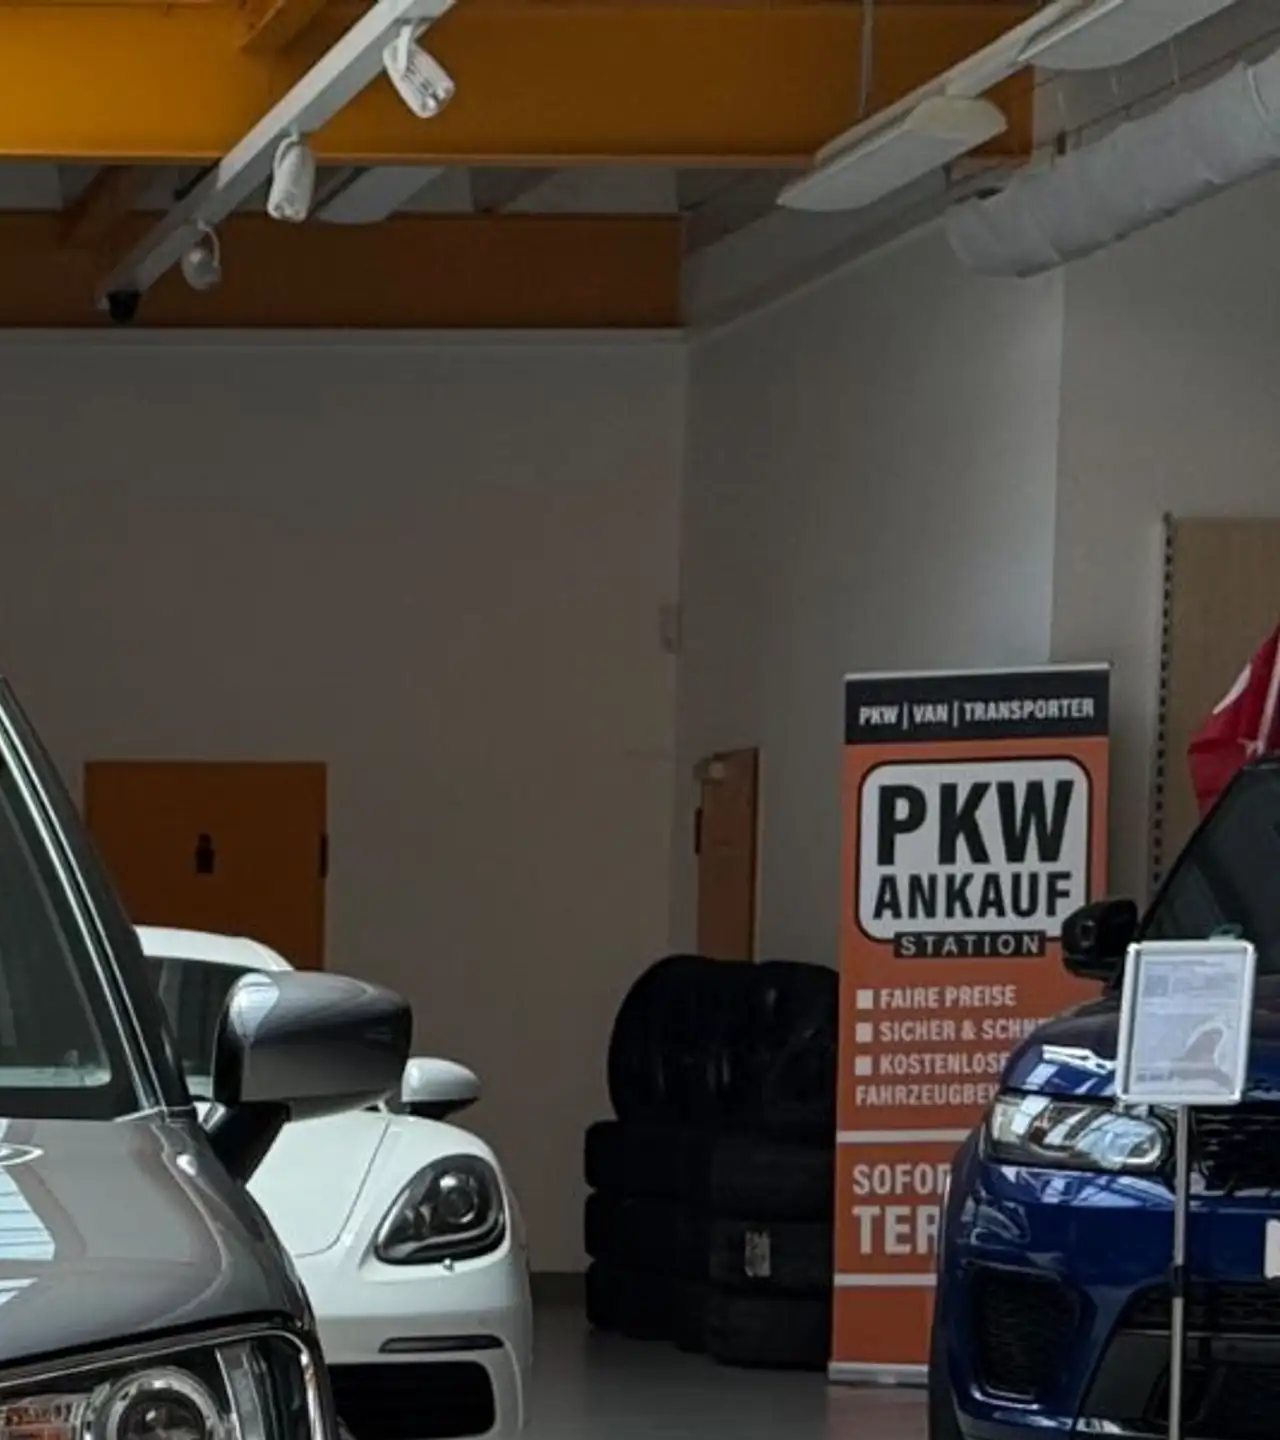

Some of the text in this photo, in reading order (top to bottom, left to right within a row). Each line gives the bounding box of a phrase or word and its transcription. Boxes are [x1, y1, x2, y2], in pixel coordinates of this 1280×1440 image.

[858, 697, 1095, 726] PKW VAN TRANSPORTER
[876, 779, 1075, 866] PKW
[872, 871, 1072, 920] ANKAUF
[899, 934, 1040, 956] STATION
[879, 985, 1018, 1010] FAIRE PREISE
[878, 1019, 956, 1042] SICHER
[960, 1020, 977, 1041] &
